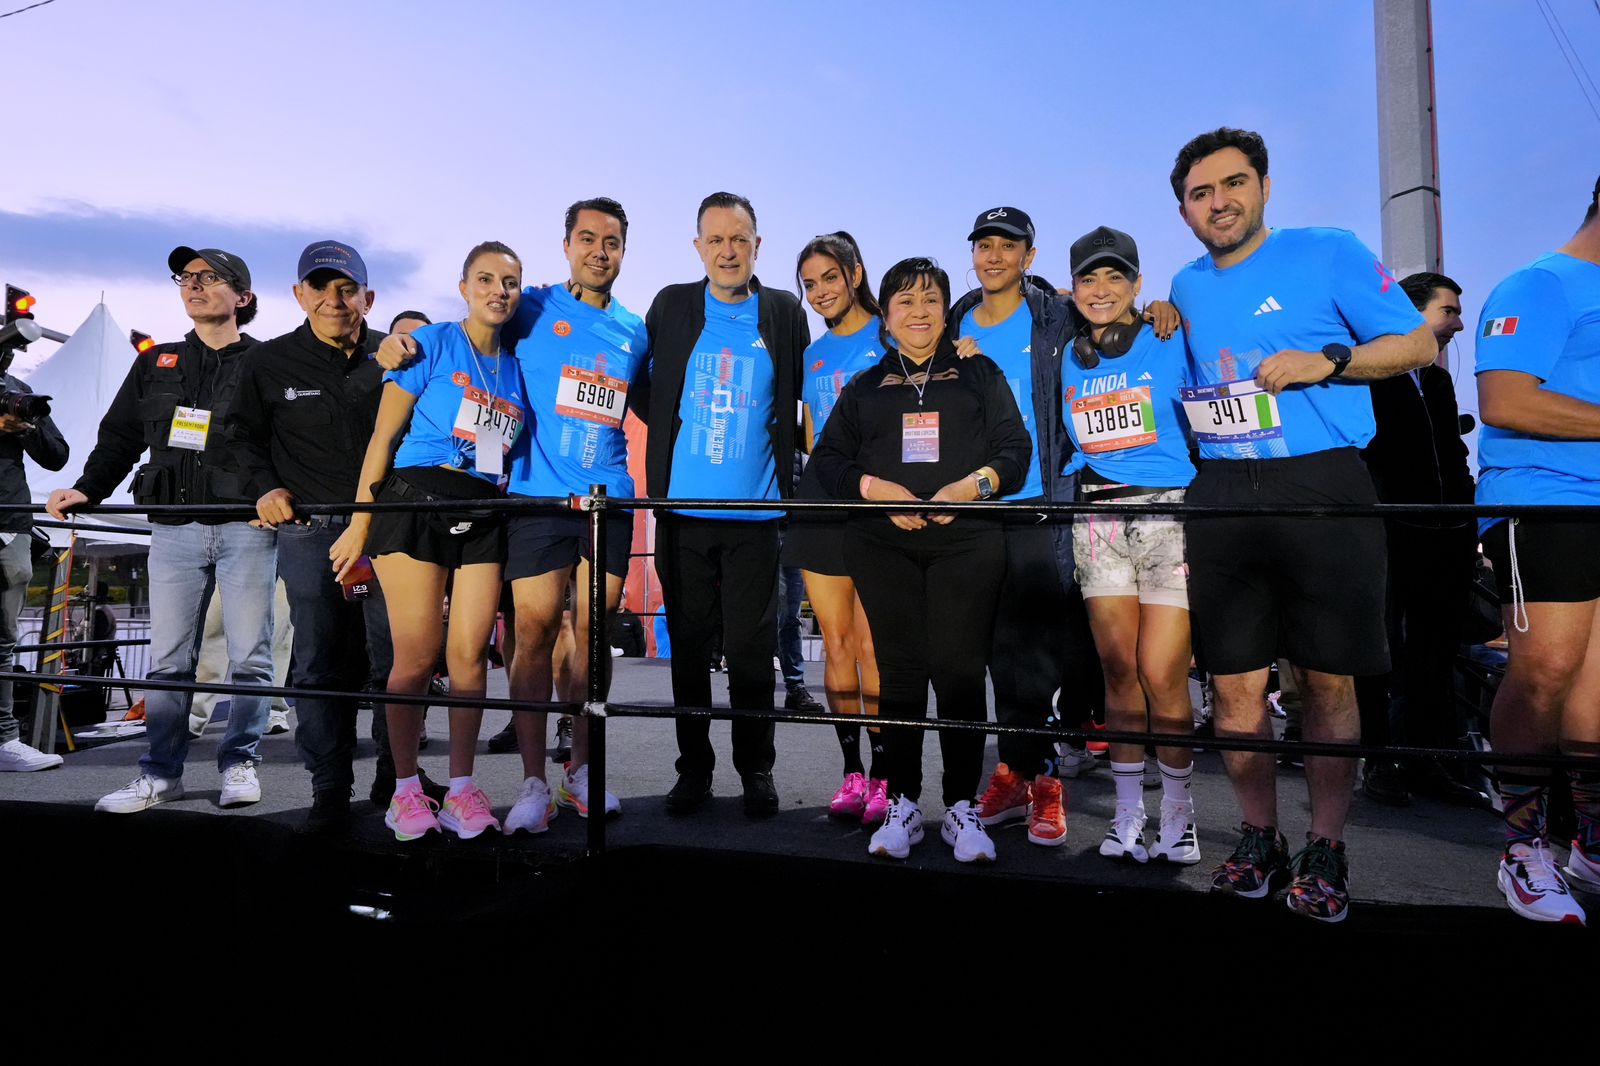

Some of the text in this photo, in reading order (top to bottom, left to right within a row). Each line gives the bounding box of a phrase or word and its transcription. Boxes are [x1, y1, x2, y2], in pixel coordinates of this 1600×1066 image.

[576, 381, 615, 410] 6980
[1082, 372, 1127, 397] LINDA
[1084, 402, 1142, 435] 13885
[1208, 397, 1248, 425] 341
